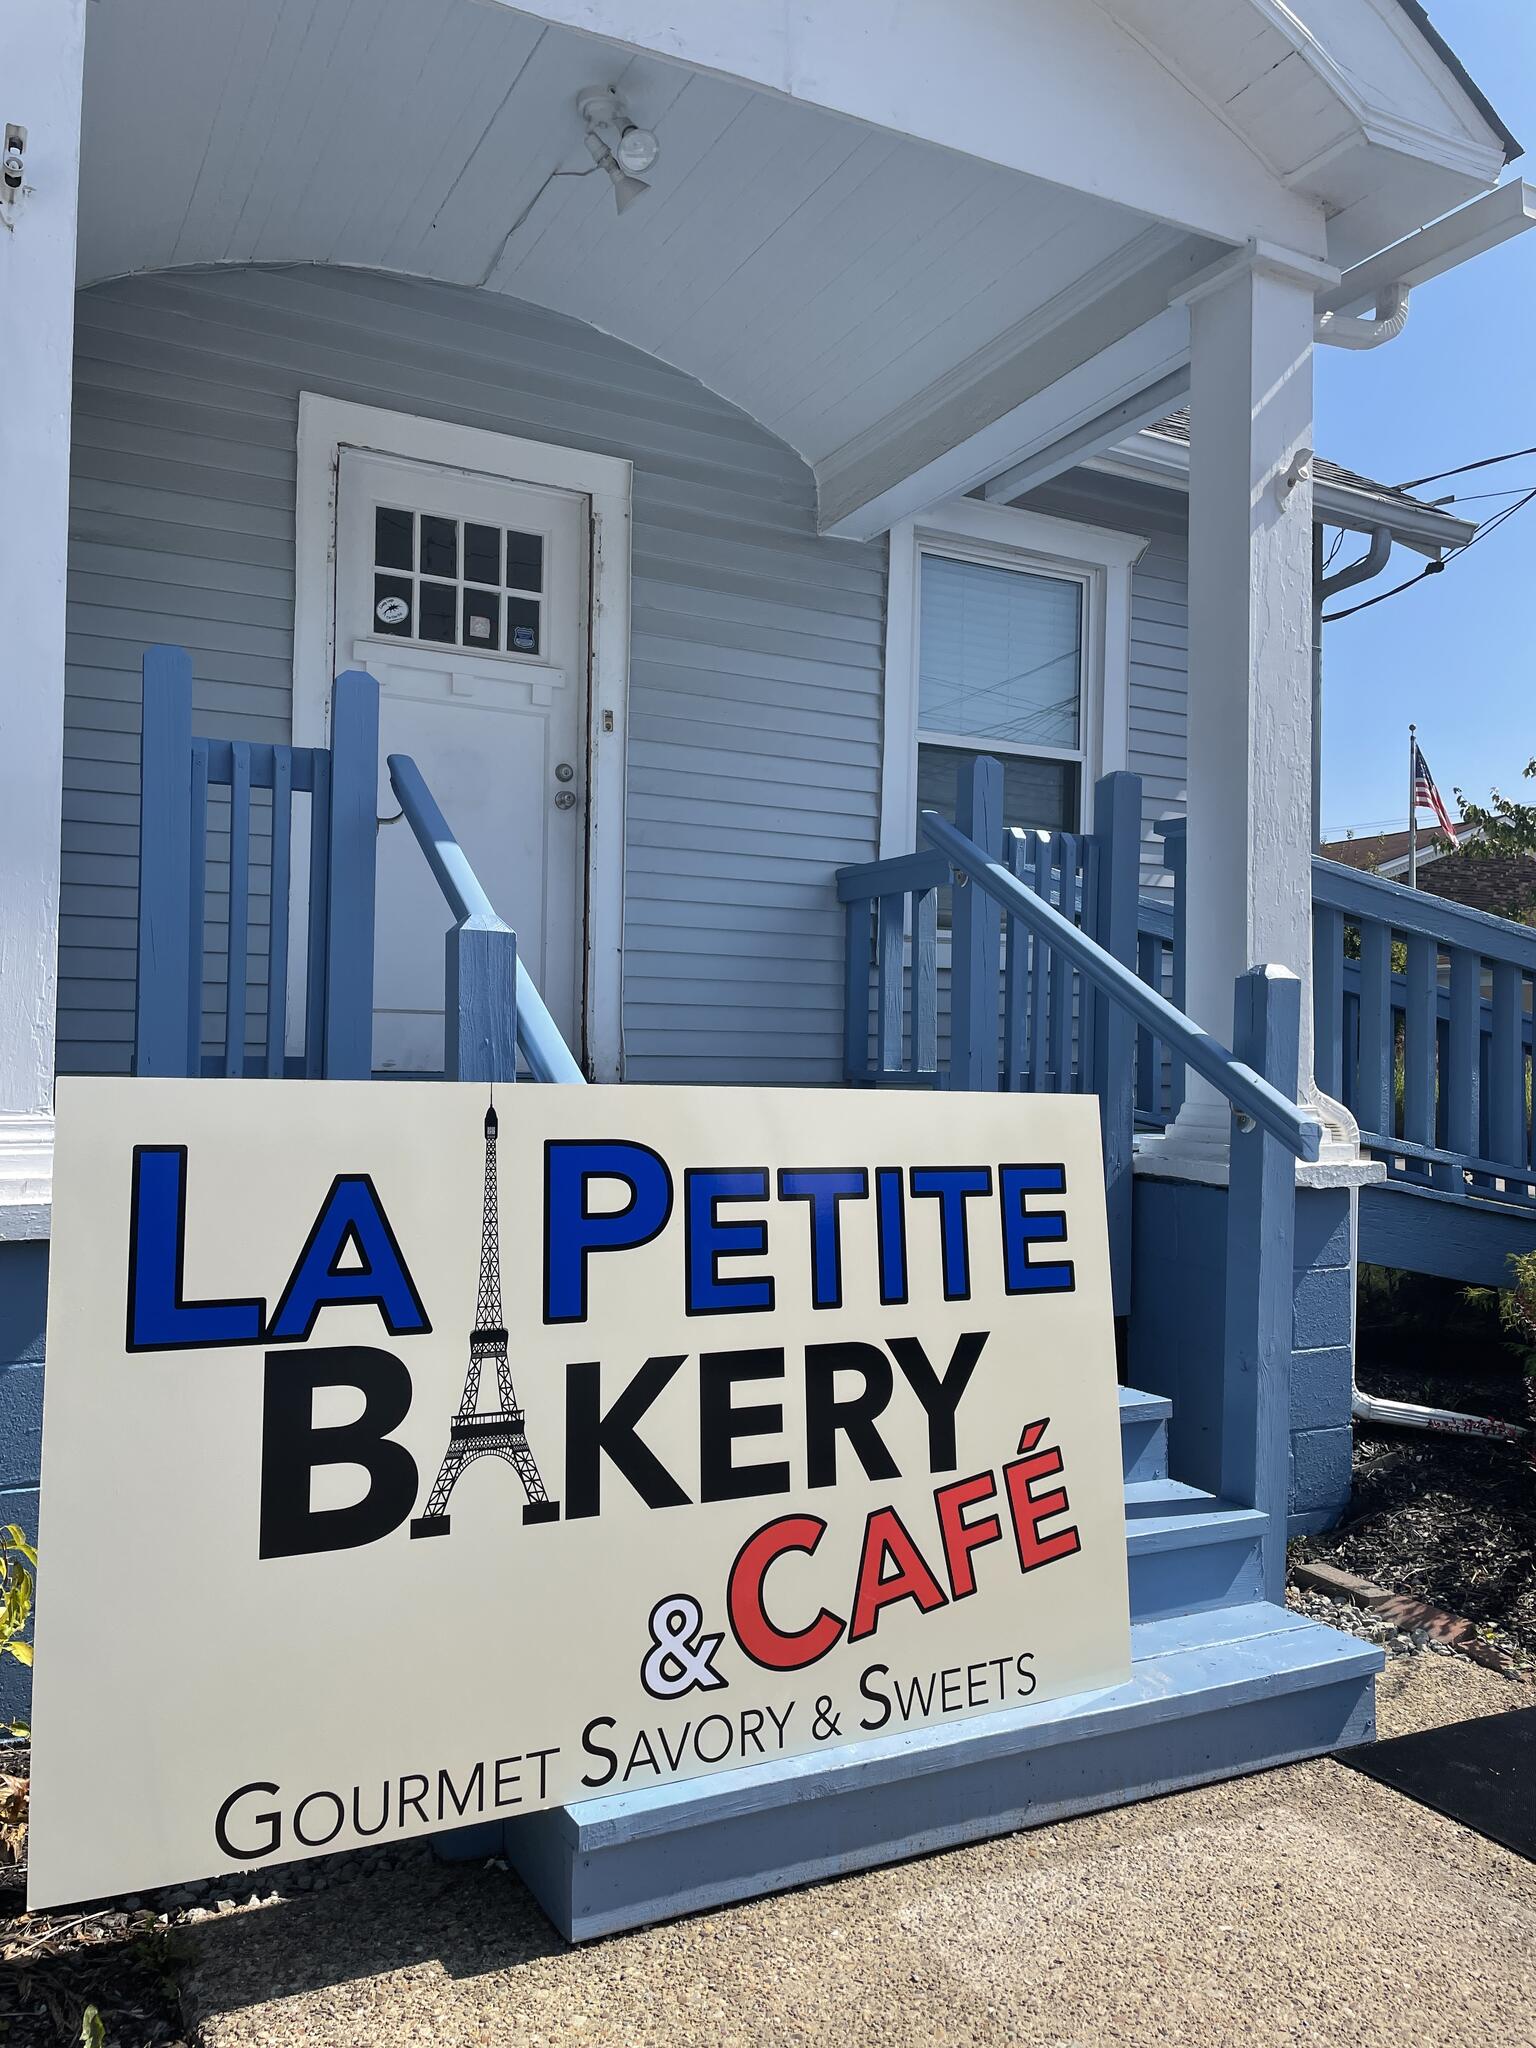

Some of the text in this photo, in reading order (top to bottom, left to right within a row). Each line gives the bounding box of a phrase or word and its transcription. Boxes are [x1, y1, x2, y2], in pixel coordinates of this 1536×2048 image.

[126, 1138, 1076, 1354] LA PETITE
[640, 1417, 1082, 1701] & CAFÉ
[214, 1651, 1037, 1861] GOURMET SAVORY & SWEETS
